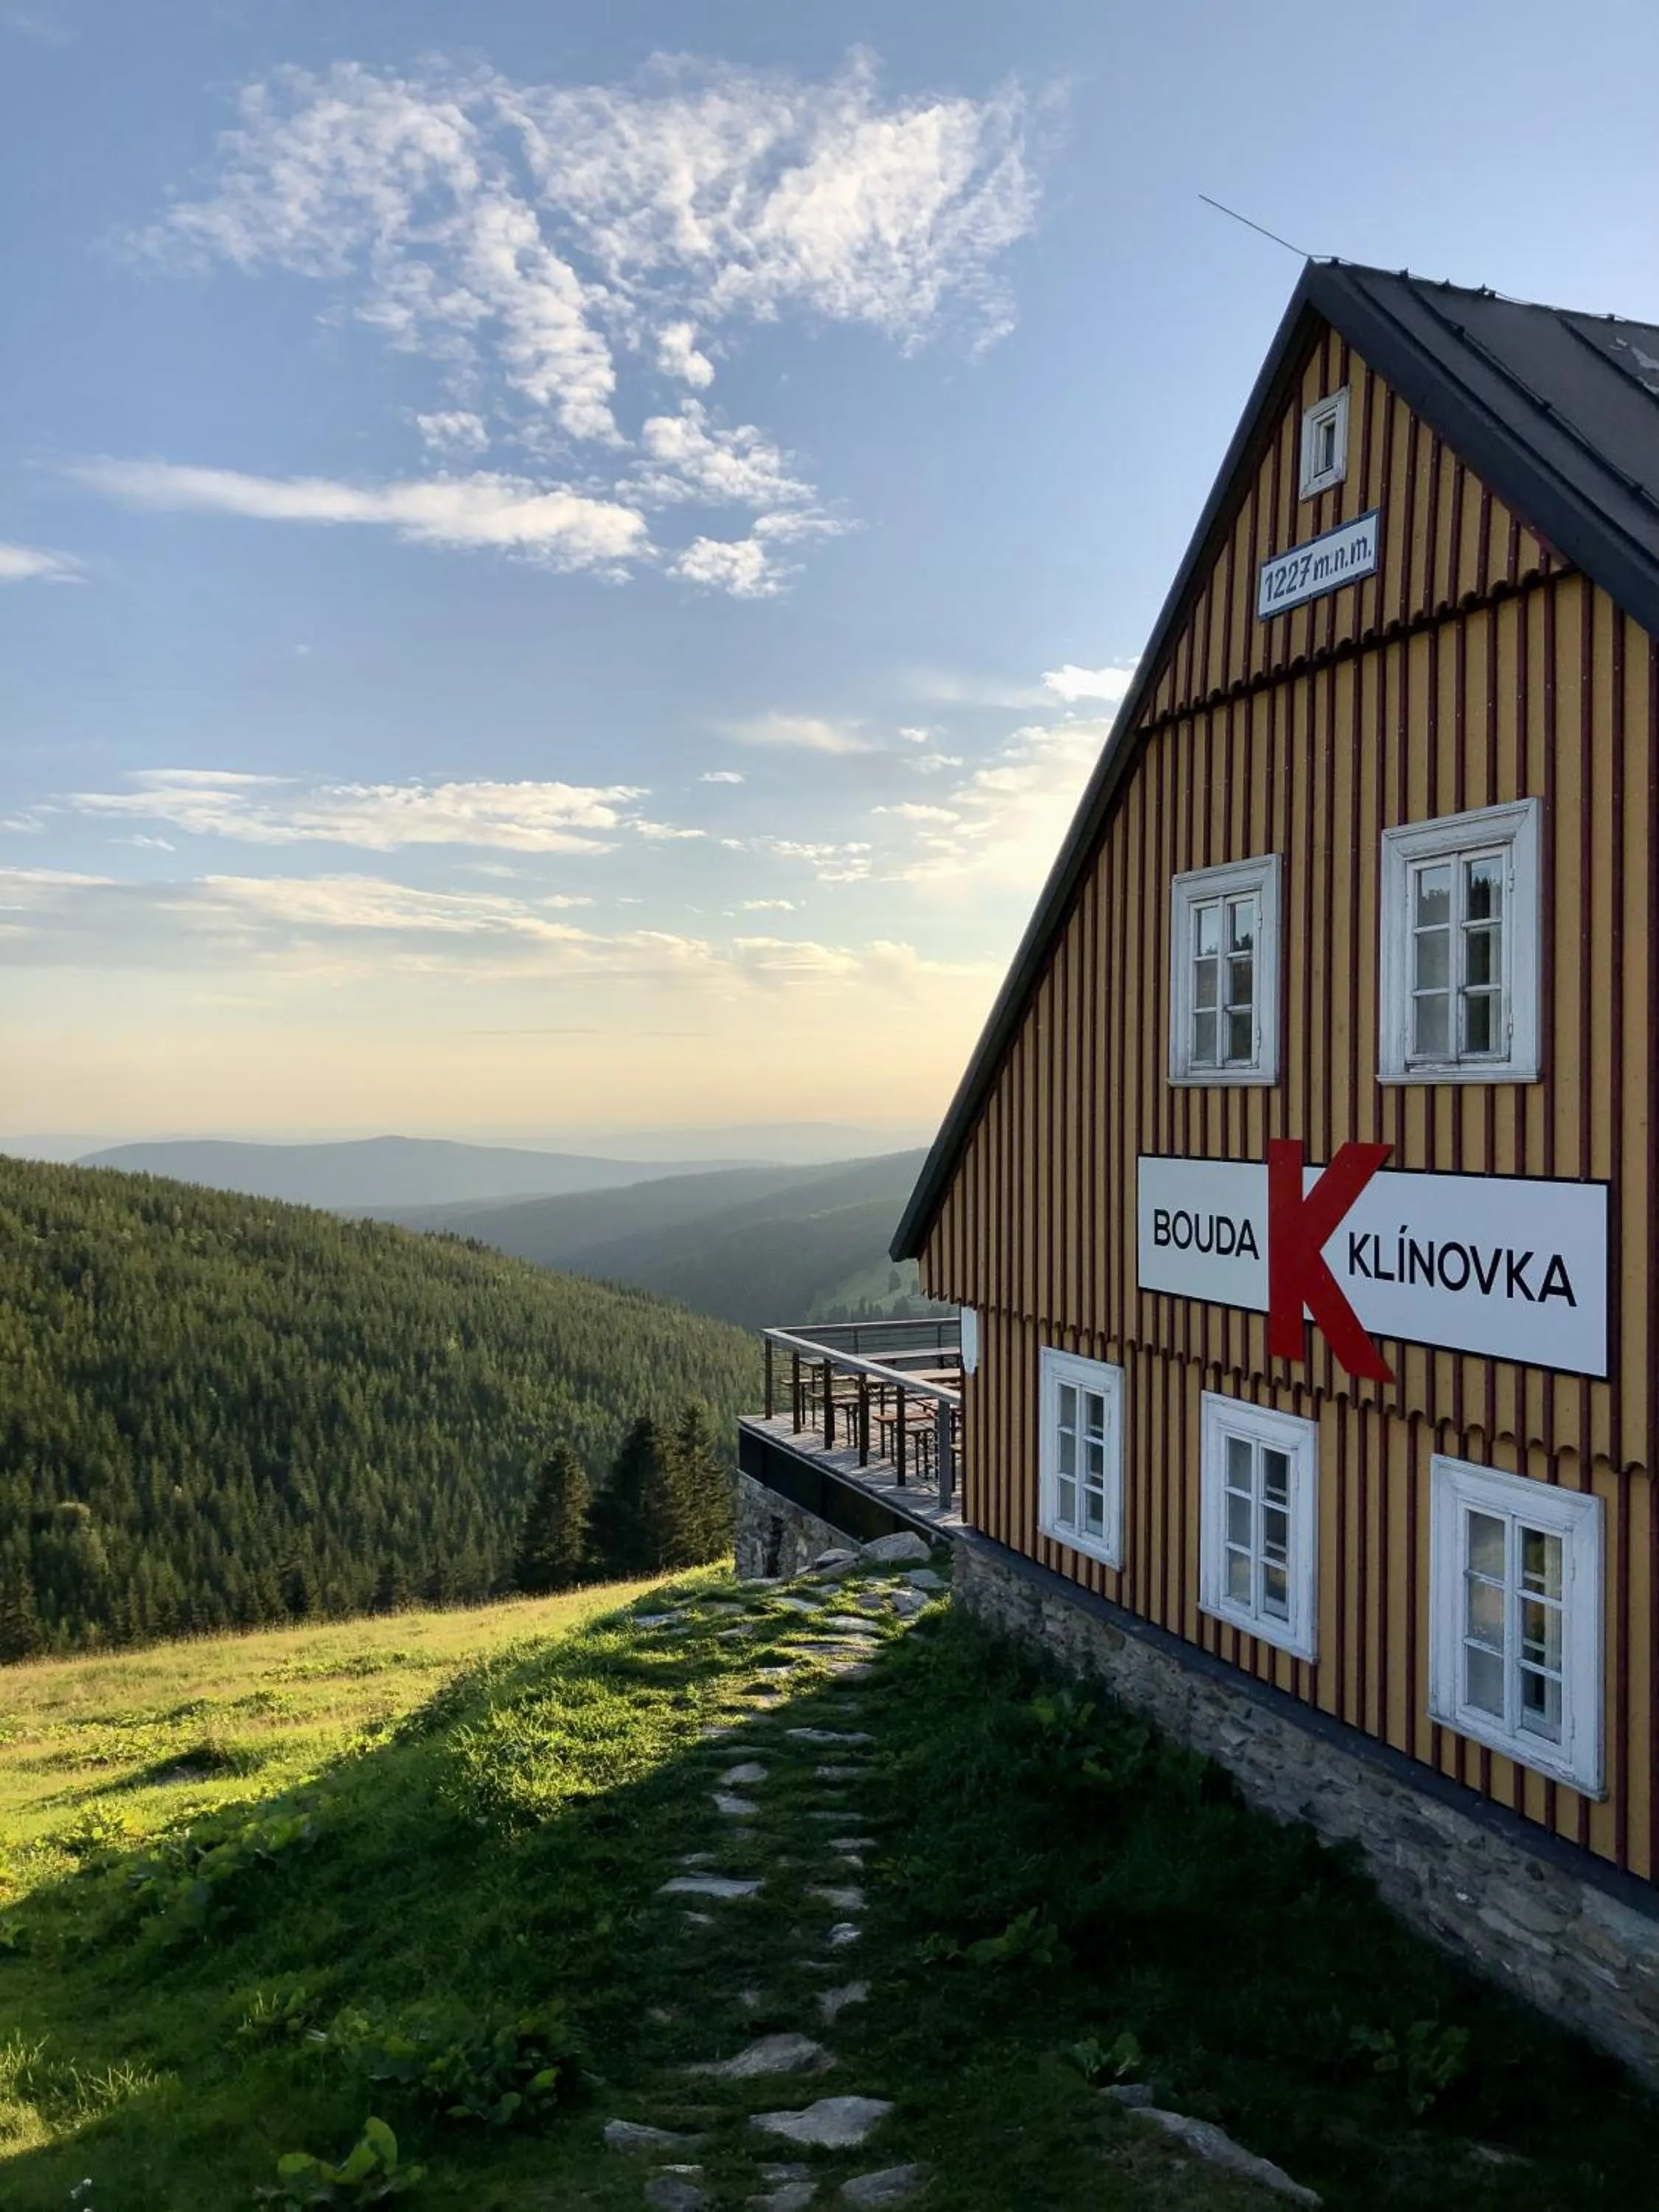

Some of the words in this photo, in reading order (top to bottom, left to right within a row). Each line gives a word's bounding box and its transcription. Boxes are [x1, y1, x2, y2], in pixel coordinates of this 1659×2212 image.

[1265, 553, 1313, 602] 1227
[1153, 1208, 1259, 1260] BOUDA
[1267, 1138, 1395, 1383] K
[1348, 1225, 1577, 1307] KLÍNOVKA
